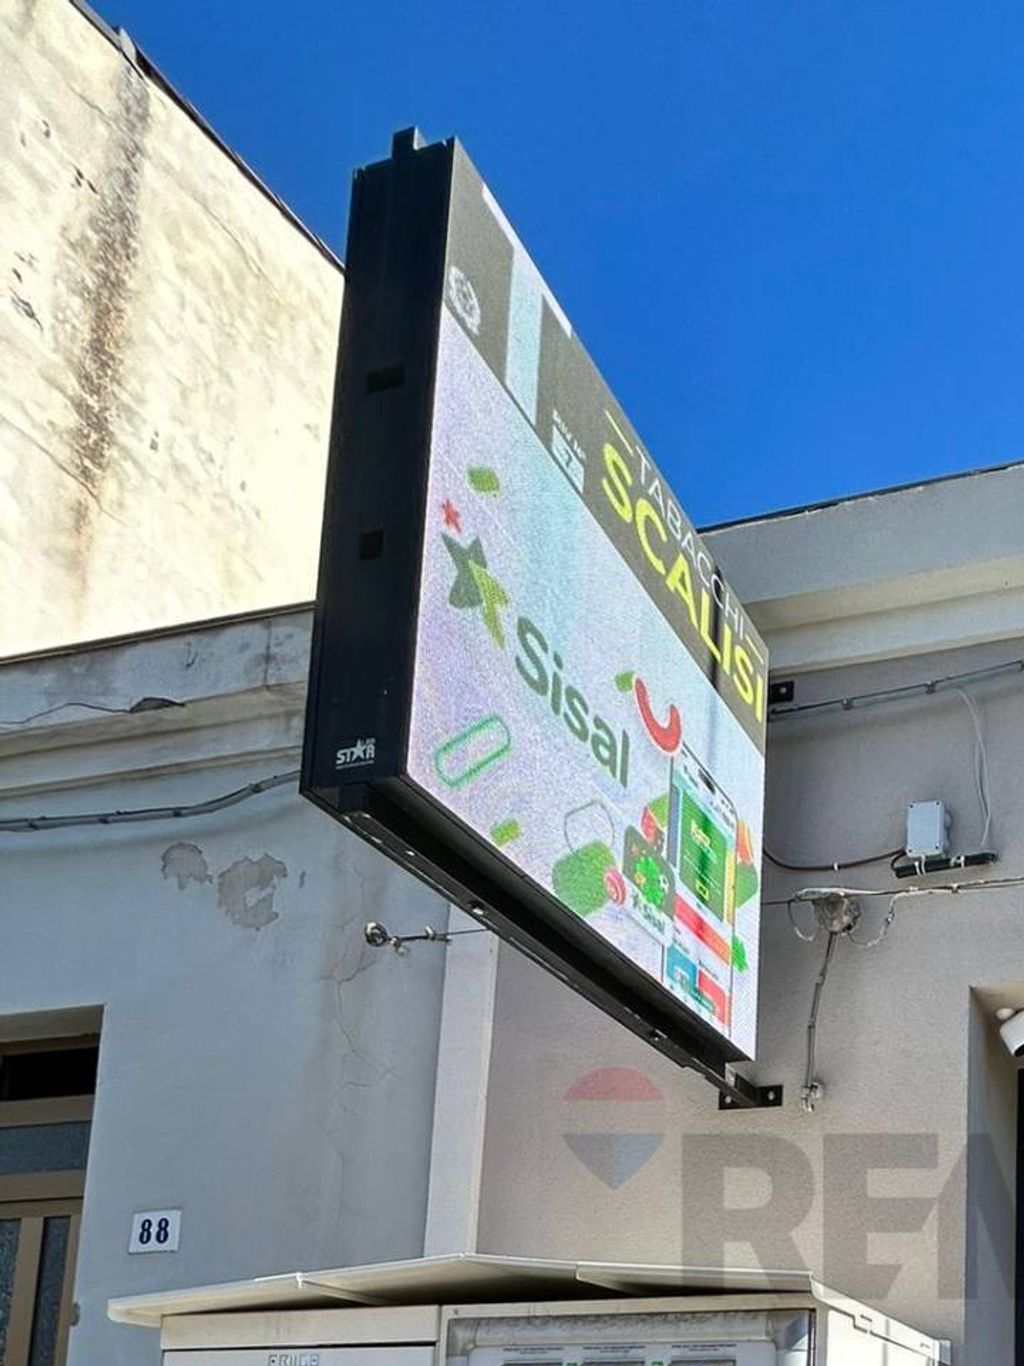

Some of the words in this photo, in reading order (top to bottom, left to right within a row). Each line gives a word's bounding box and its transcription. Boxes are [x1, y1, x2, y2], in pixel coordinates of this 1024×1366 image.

[602, 443, 764, 720] SCALISI
[636, 446, 745, 641] TABACCHI
[515, 616, 630, 789] Sisal
[138, 1217, 170, 1245] 88
